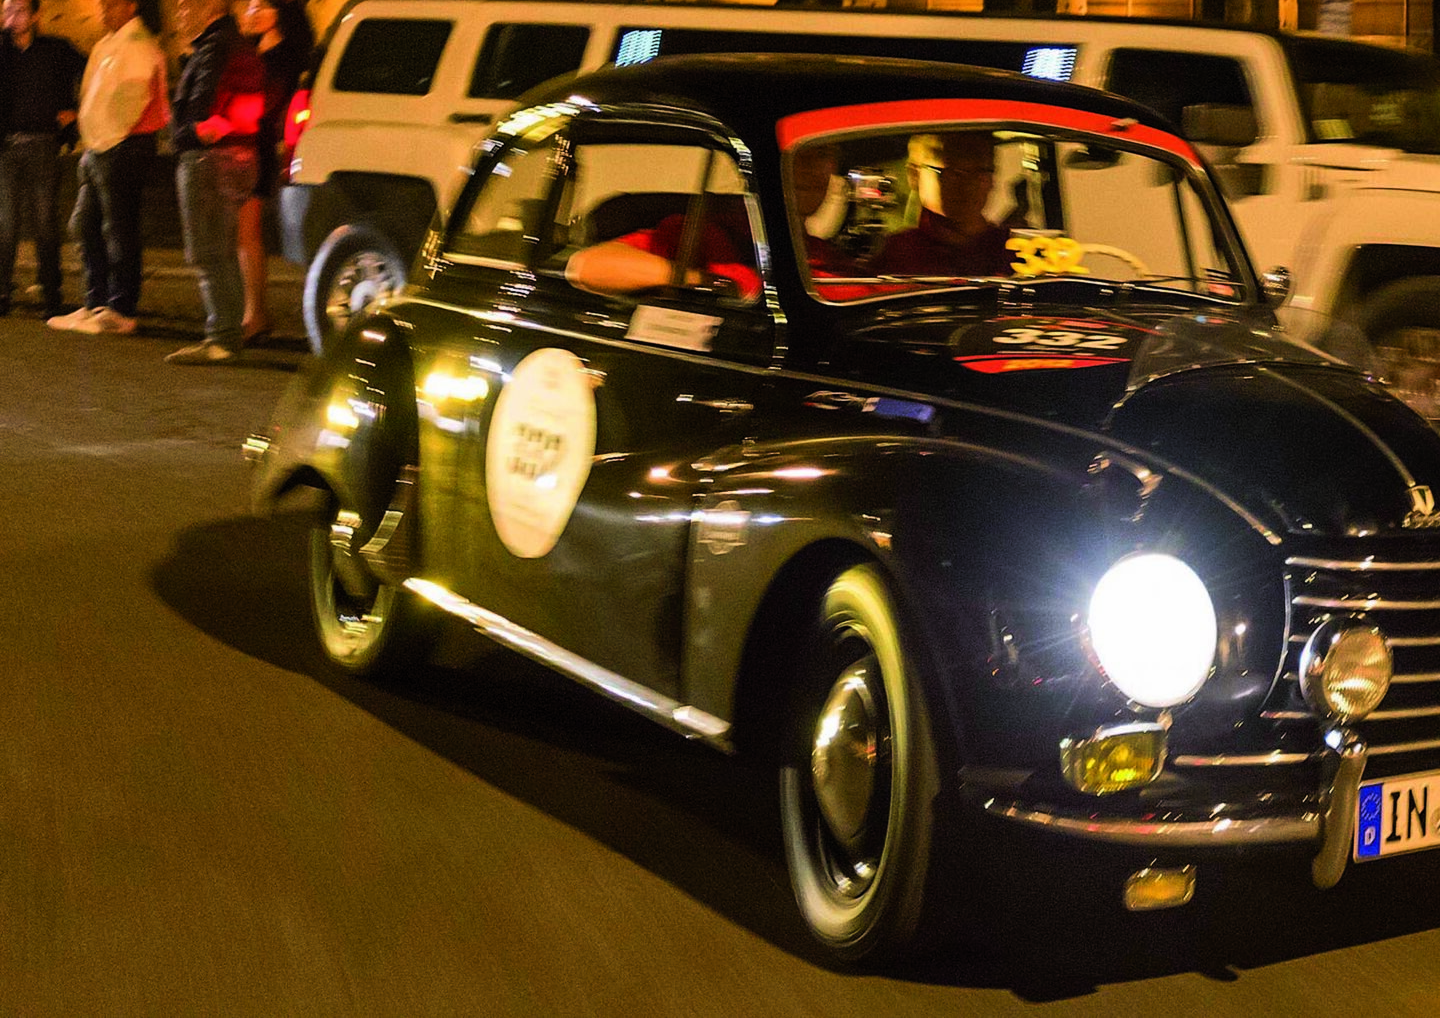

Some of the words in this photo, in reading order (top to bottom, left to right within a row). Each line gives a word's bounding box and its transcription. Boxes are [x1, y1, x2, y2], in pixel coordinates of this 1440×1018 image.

[992, 328, 1128, 349] 332
[1386, 785, 1428, 842] IN
[1365, 826, 1376, 846] D
